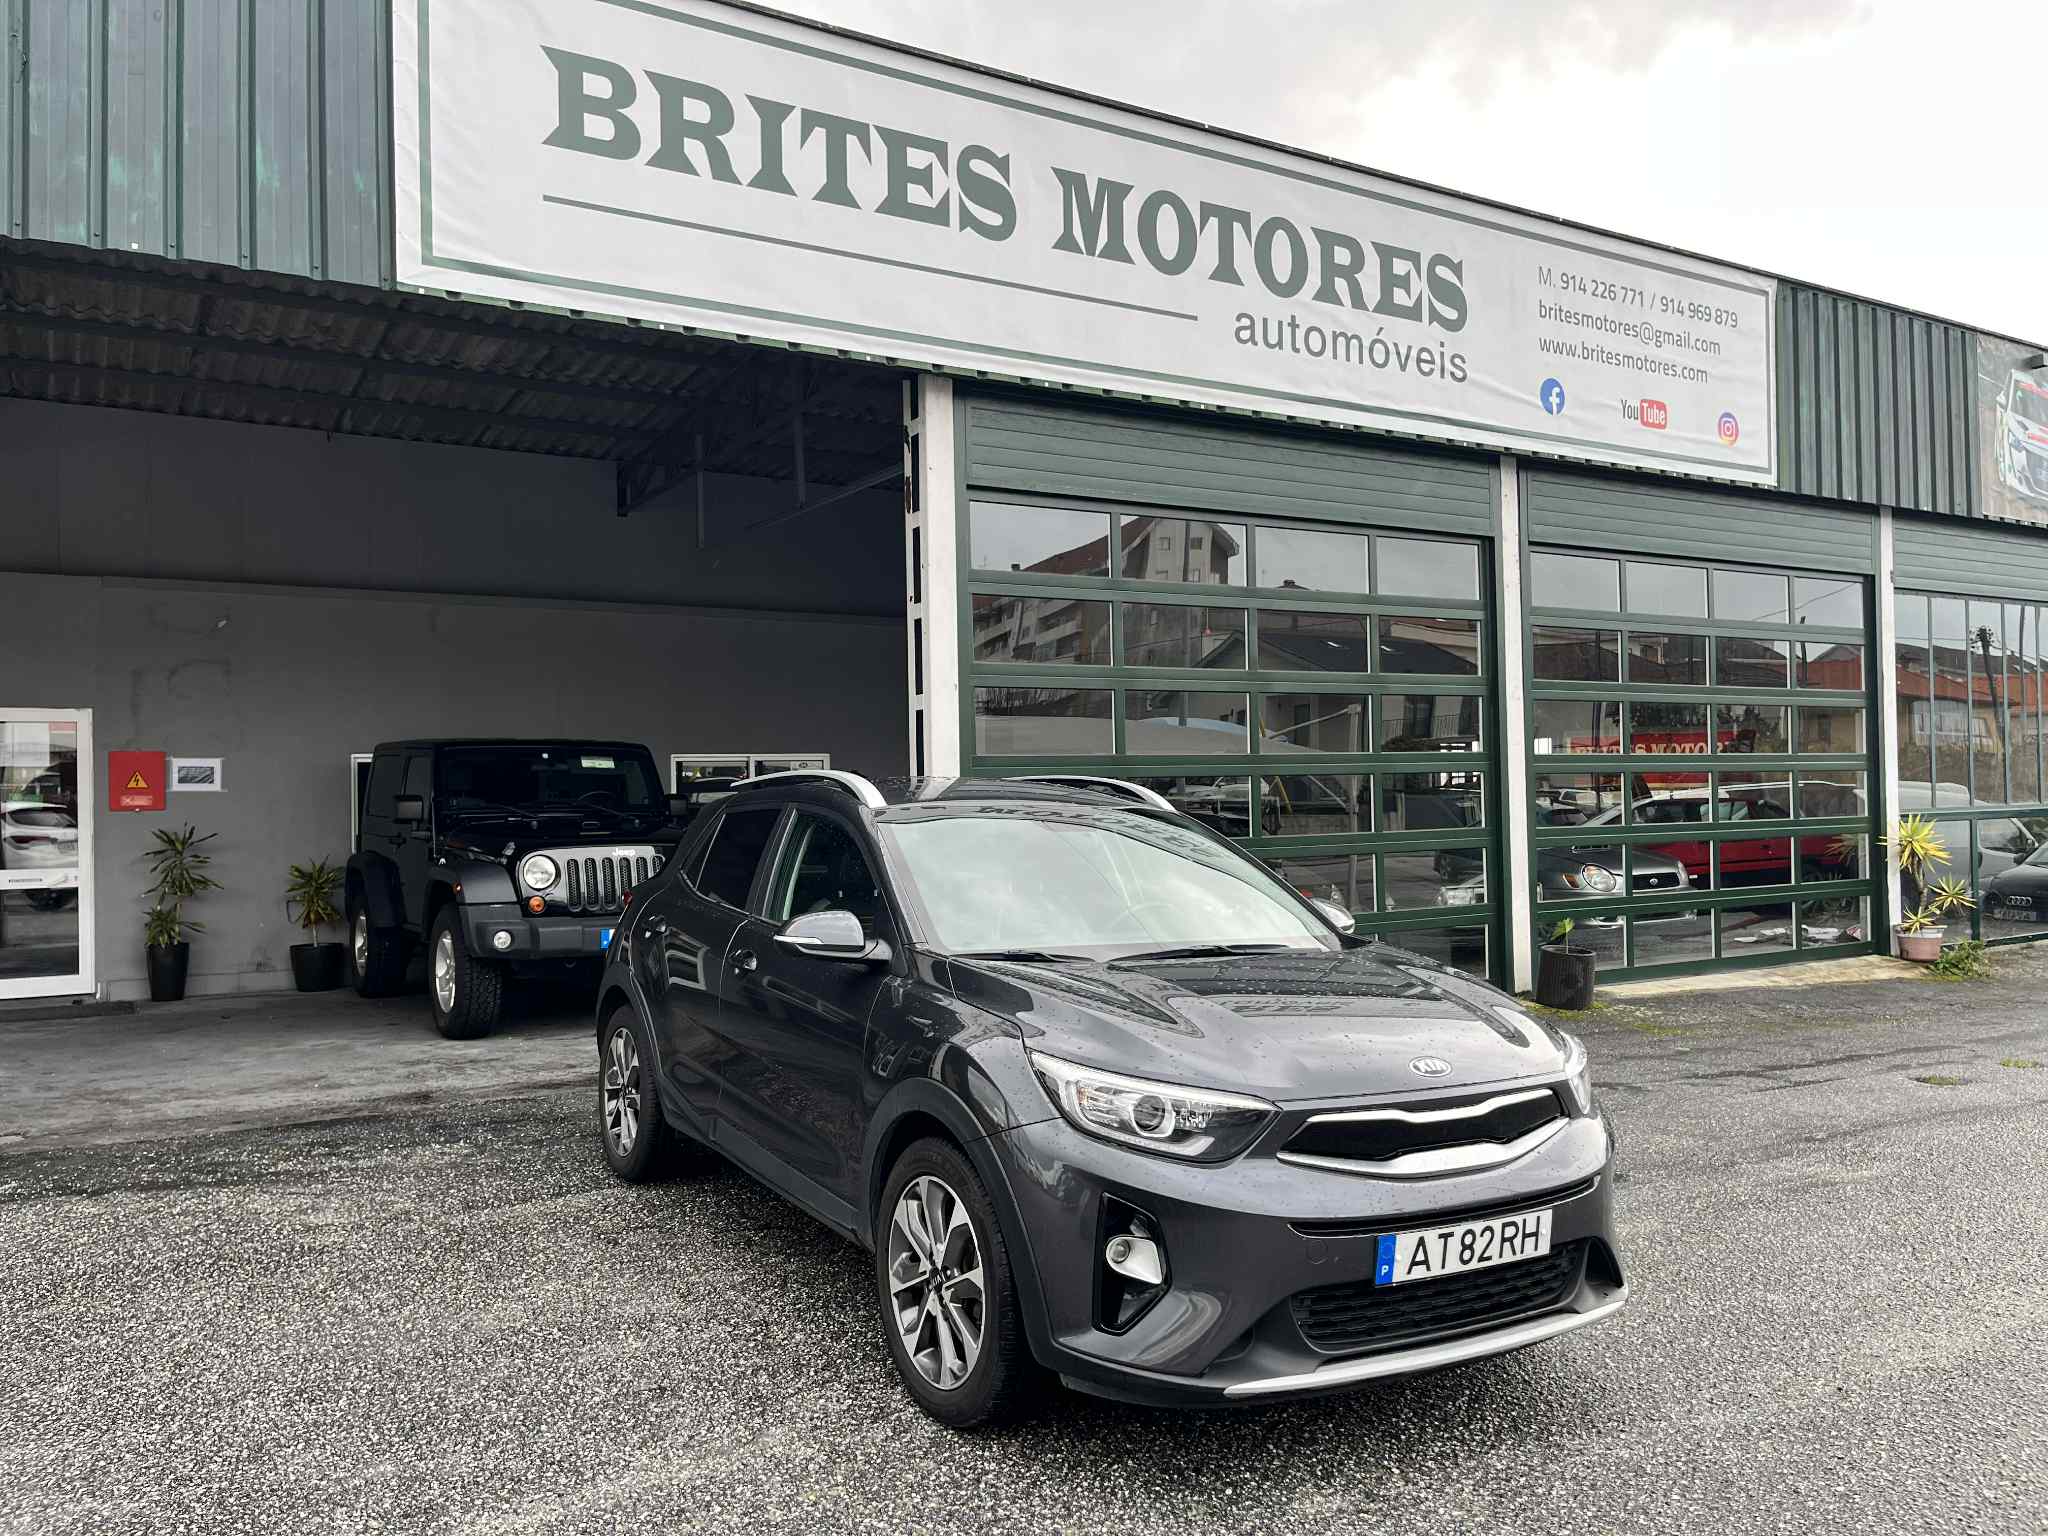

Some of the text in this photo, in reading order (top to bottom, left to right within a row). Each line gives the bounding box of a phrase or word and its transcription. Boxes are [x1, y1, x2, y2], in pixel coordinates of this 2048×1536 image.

[541, 45, 1468, 333] BRITES MOTORES
[1538, 300, 1721, 356] britesmotores@gmail.com
[1560, 272, 1587, 295] 914
[1591, 279, 1617, 302] 226
[1620, 286, 1644, 308] 771
[1660, 295, 1685, 317] 914
[1688, 301, 1712, 323] 969
[1714, 307, 1738, 329] 879
[1234, 312, 1468, 383] automóveis
[1538, 336, 1709, 384] www.britesmotores.com
[1406, 1216, 1541, 1275] AT82RH
